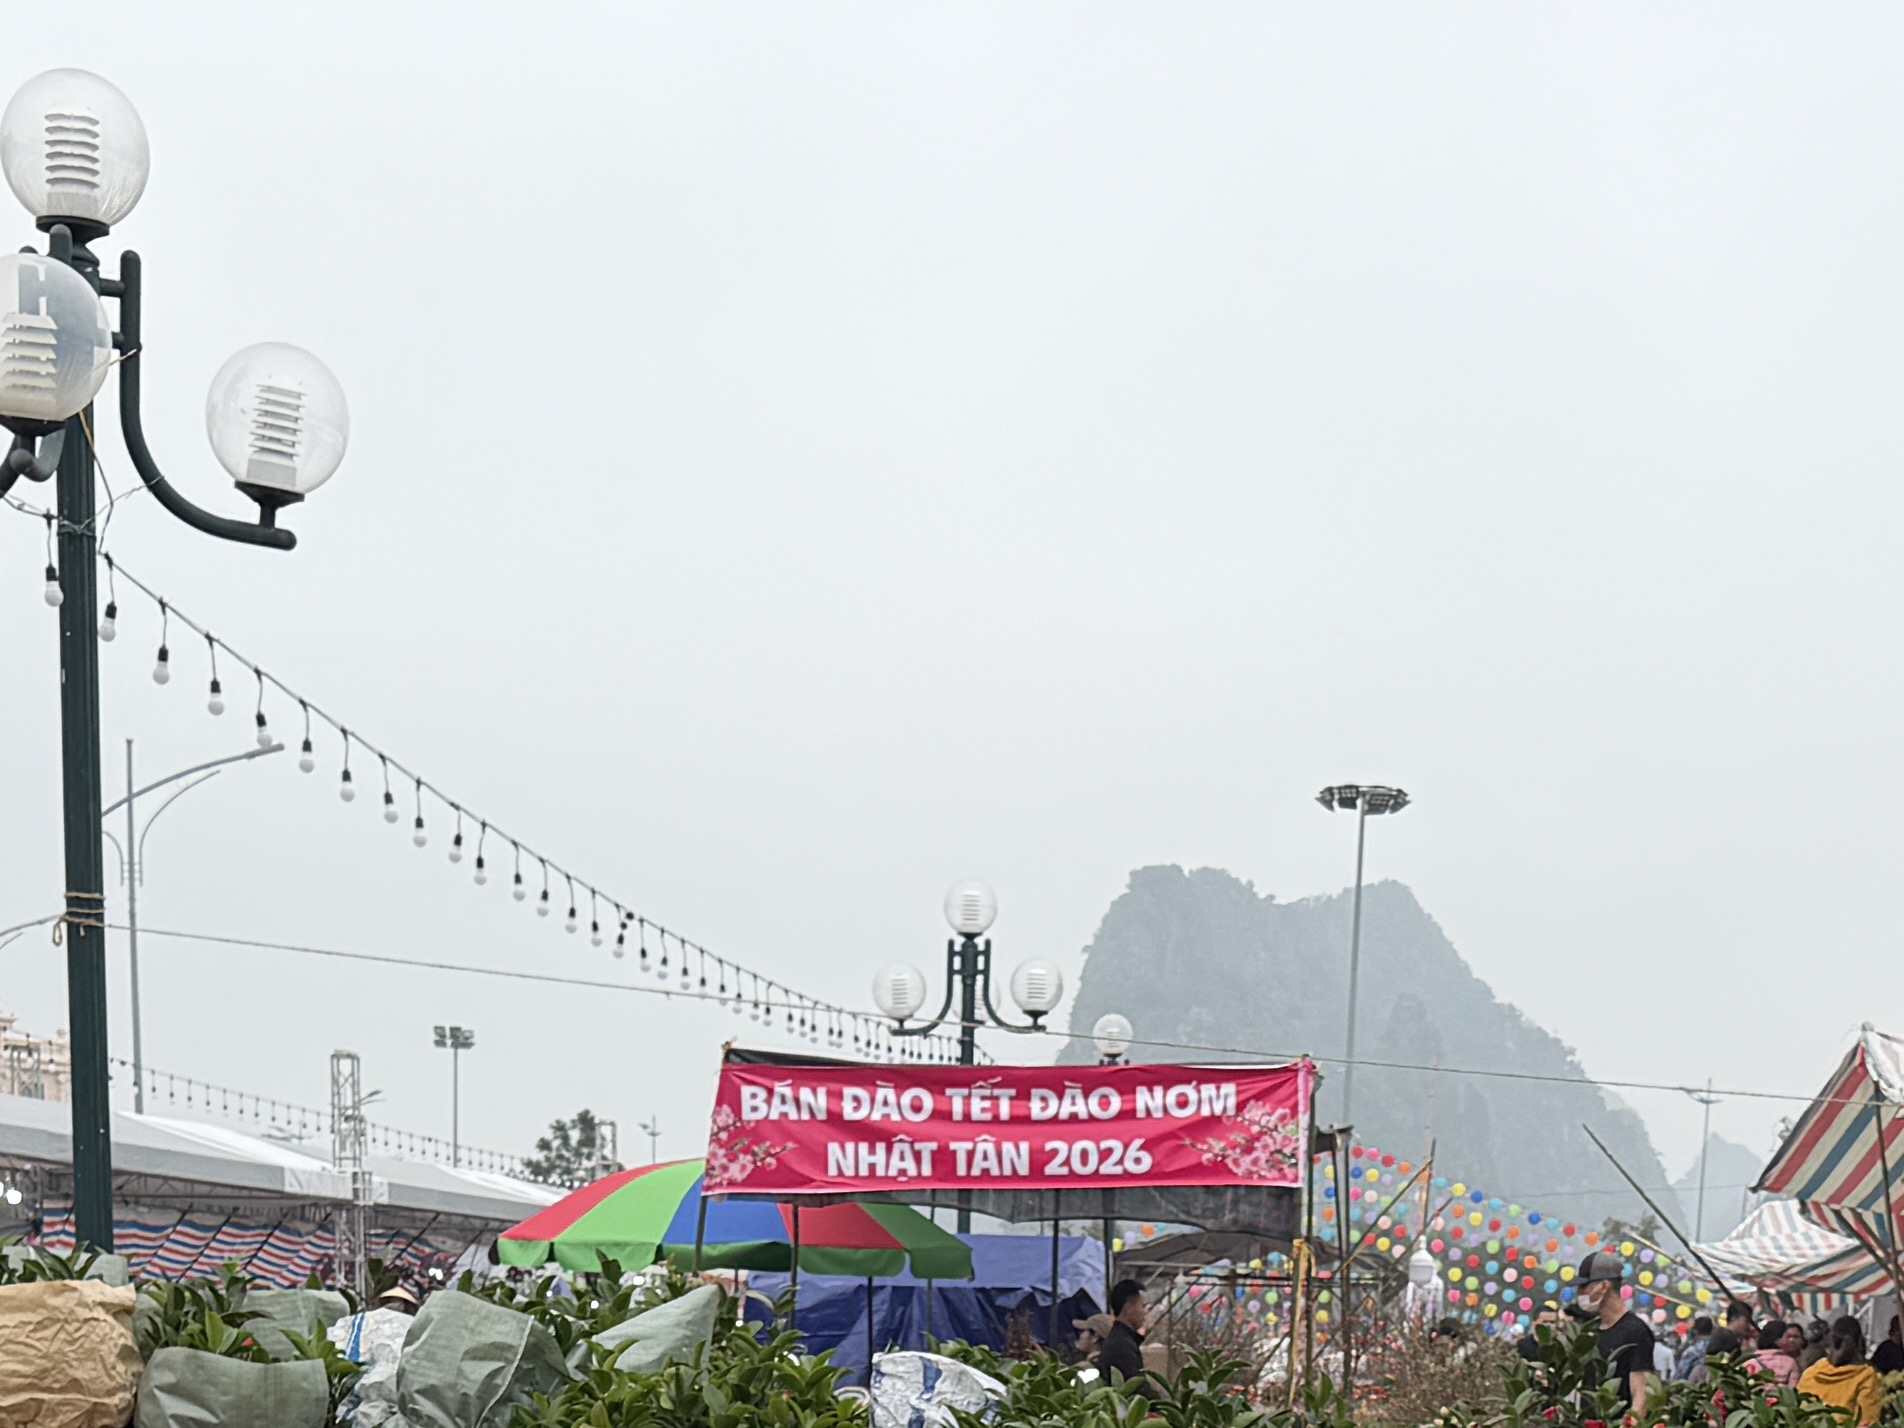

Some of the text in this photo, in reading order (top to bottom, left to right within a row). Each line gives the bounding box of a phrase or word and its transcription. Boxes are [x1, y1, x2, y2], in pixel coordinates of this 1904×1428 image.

[740, 1079, 828, 1121] BÁN
[842, 1080, 934, 1122] ĐÀO
[945, 1076, 1017, 1122] TẾT
[1029, 1080, 1122, 1121] ĐÀO
[827, 1133, 1153, 1182] NHẬT TÂN 2026
